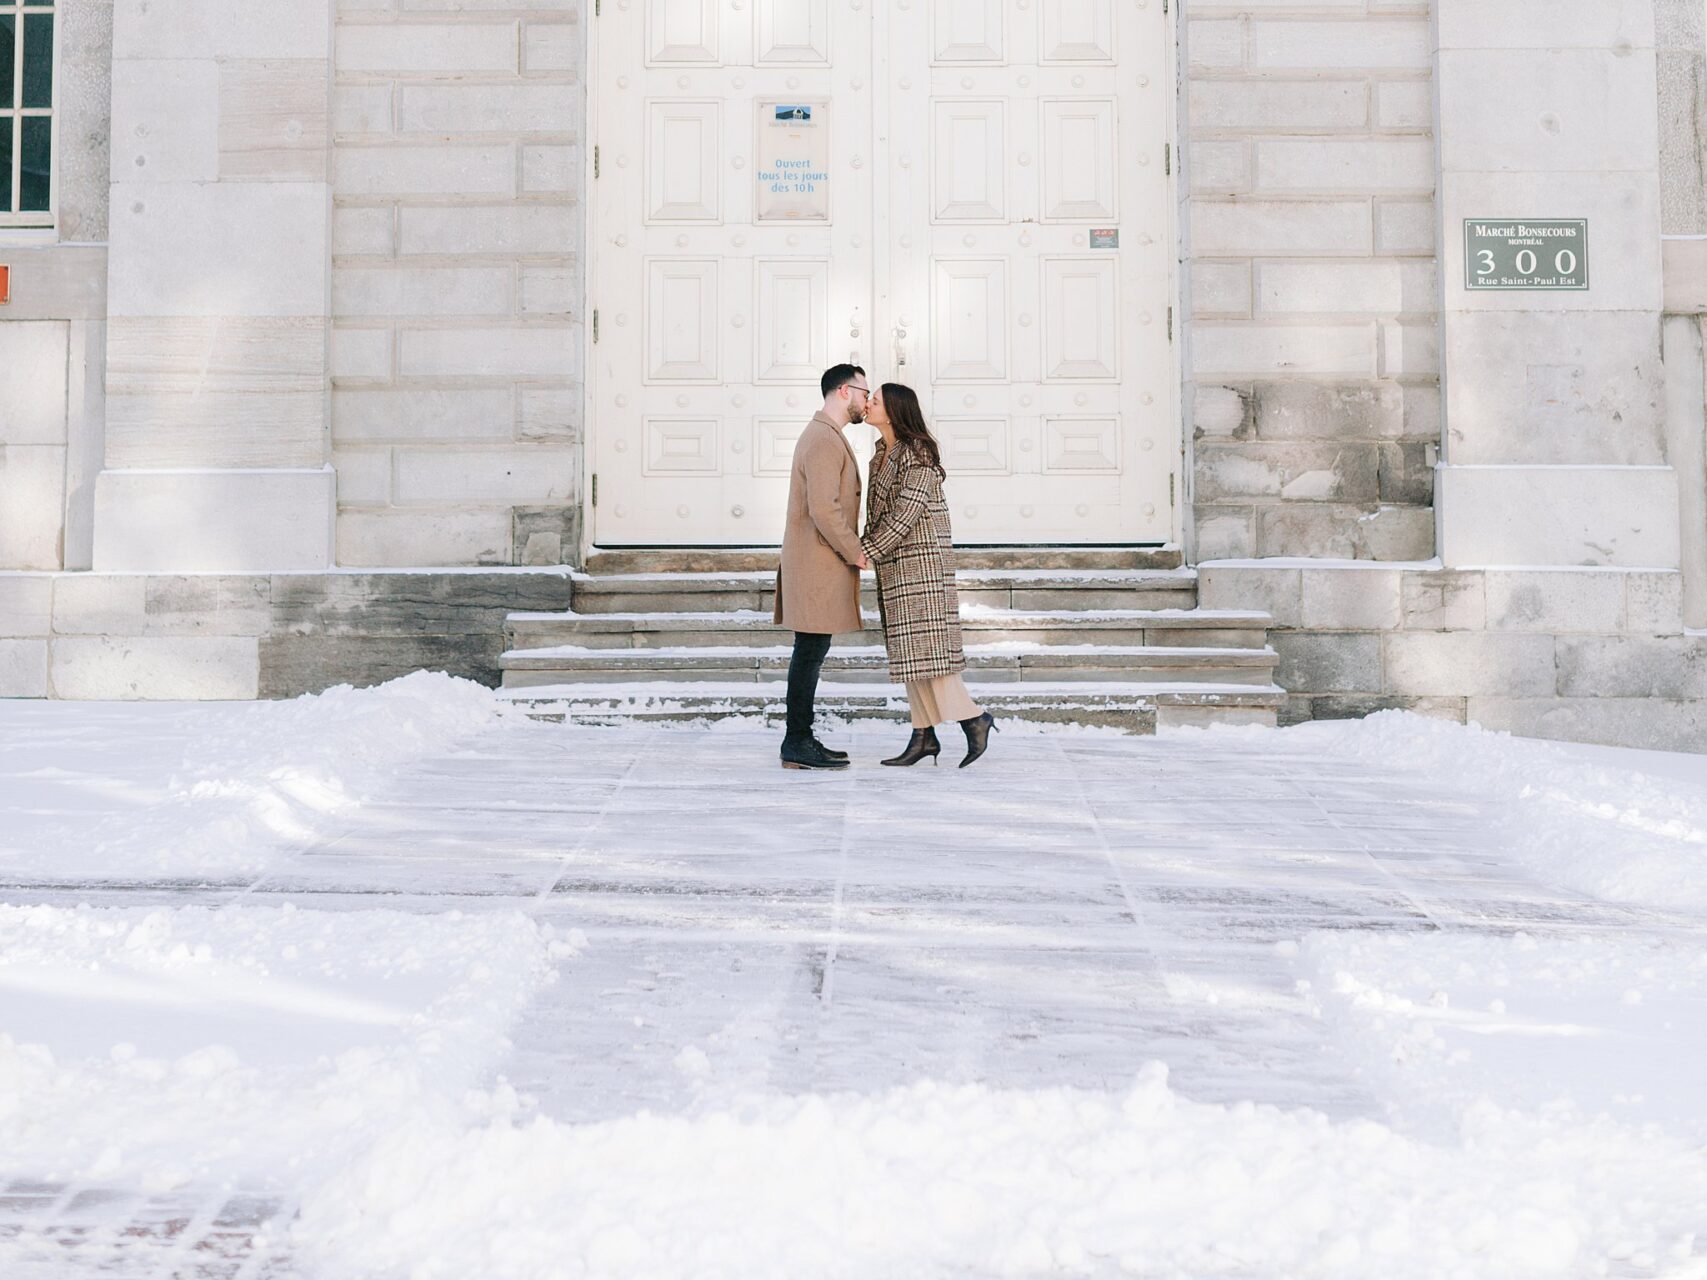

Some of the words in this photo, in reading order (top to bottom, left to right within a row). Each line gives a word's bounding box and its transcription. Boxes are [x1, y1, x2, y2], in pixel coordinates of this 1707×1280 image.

[775, 159, 811, 168] Ouvert
[758, 171, 780, 180] tous
[784, 171, 798, 180] les
[802, 171, 828, 182] jours
[1478, 277, 1498, 285] Rue
[1560, 277, 1576, 285] Est
